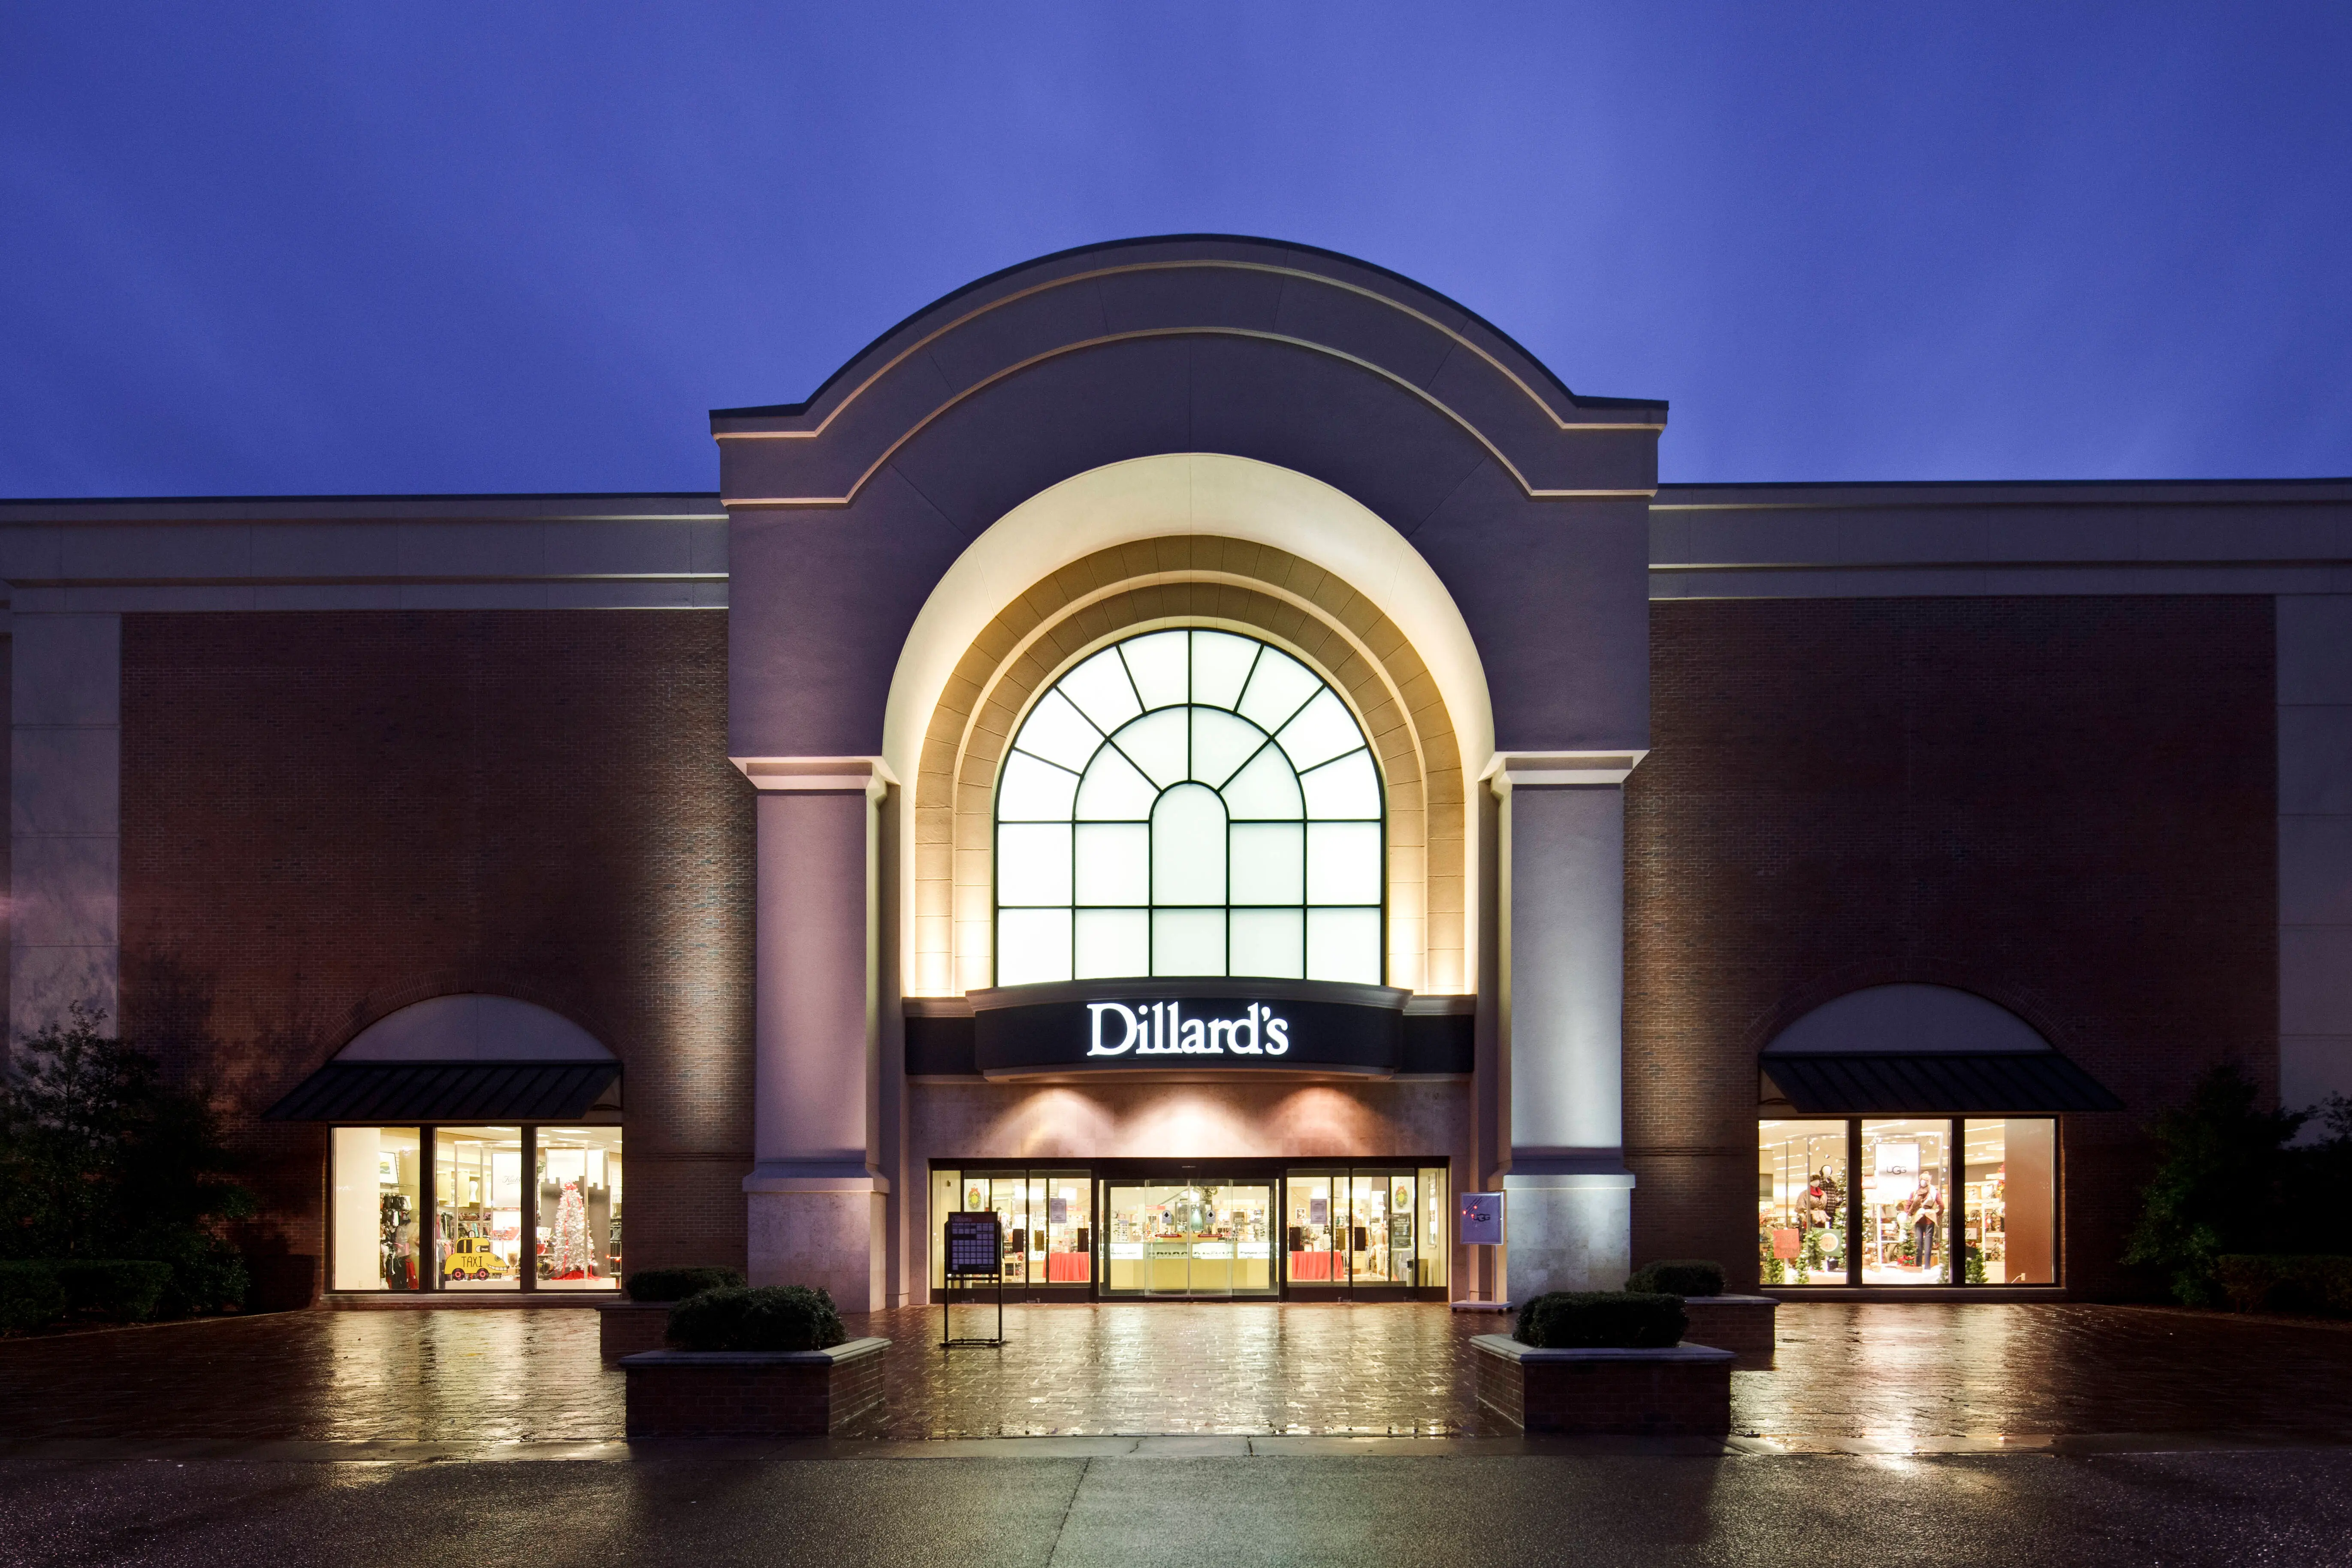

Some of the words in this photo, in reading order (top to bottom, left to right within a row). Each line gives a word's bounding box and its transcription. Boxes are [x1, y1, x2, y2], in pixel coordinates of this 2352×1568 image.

[1087, 1001, 1289, 1056] Dillard's
[1886, 1166, 1907, 1175] UGG
[1472, 1213, 1491, 1222] UGG
[461, 1256, 483, 1267] TAXI
